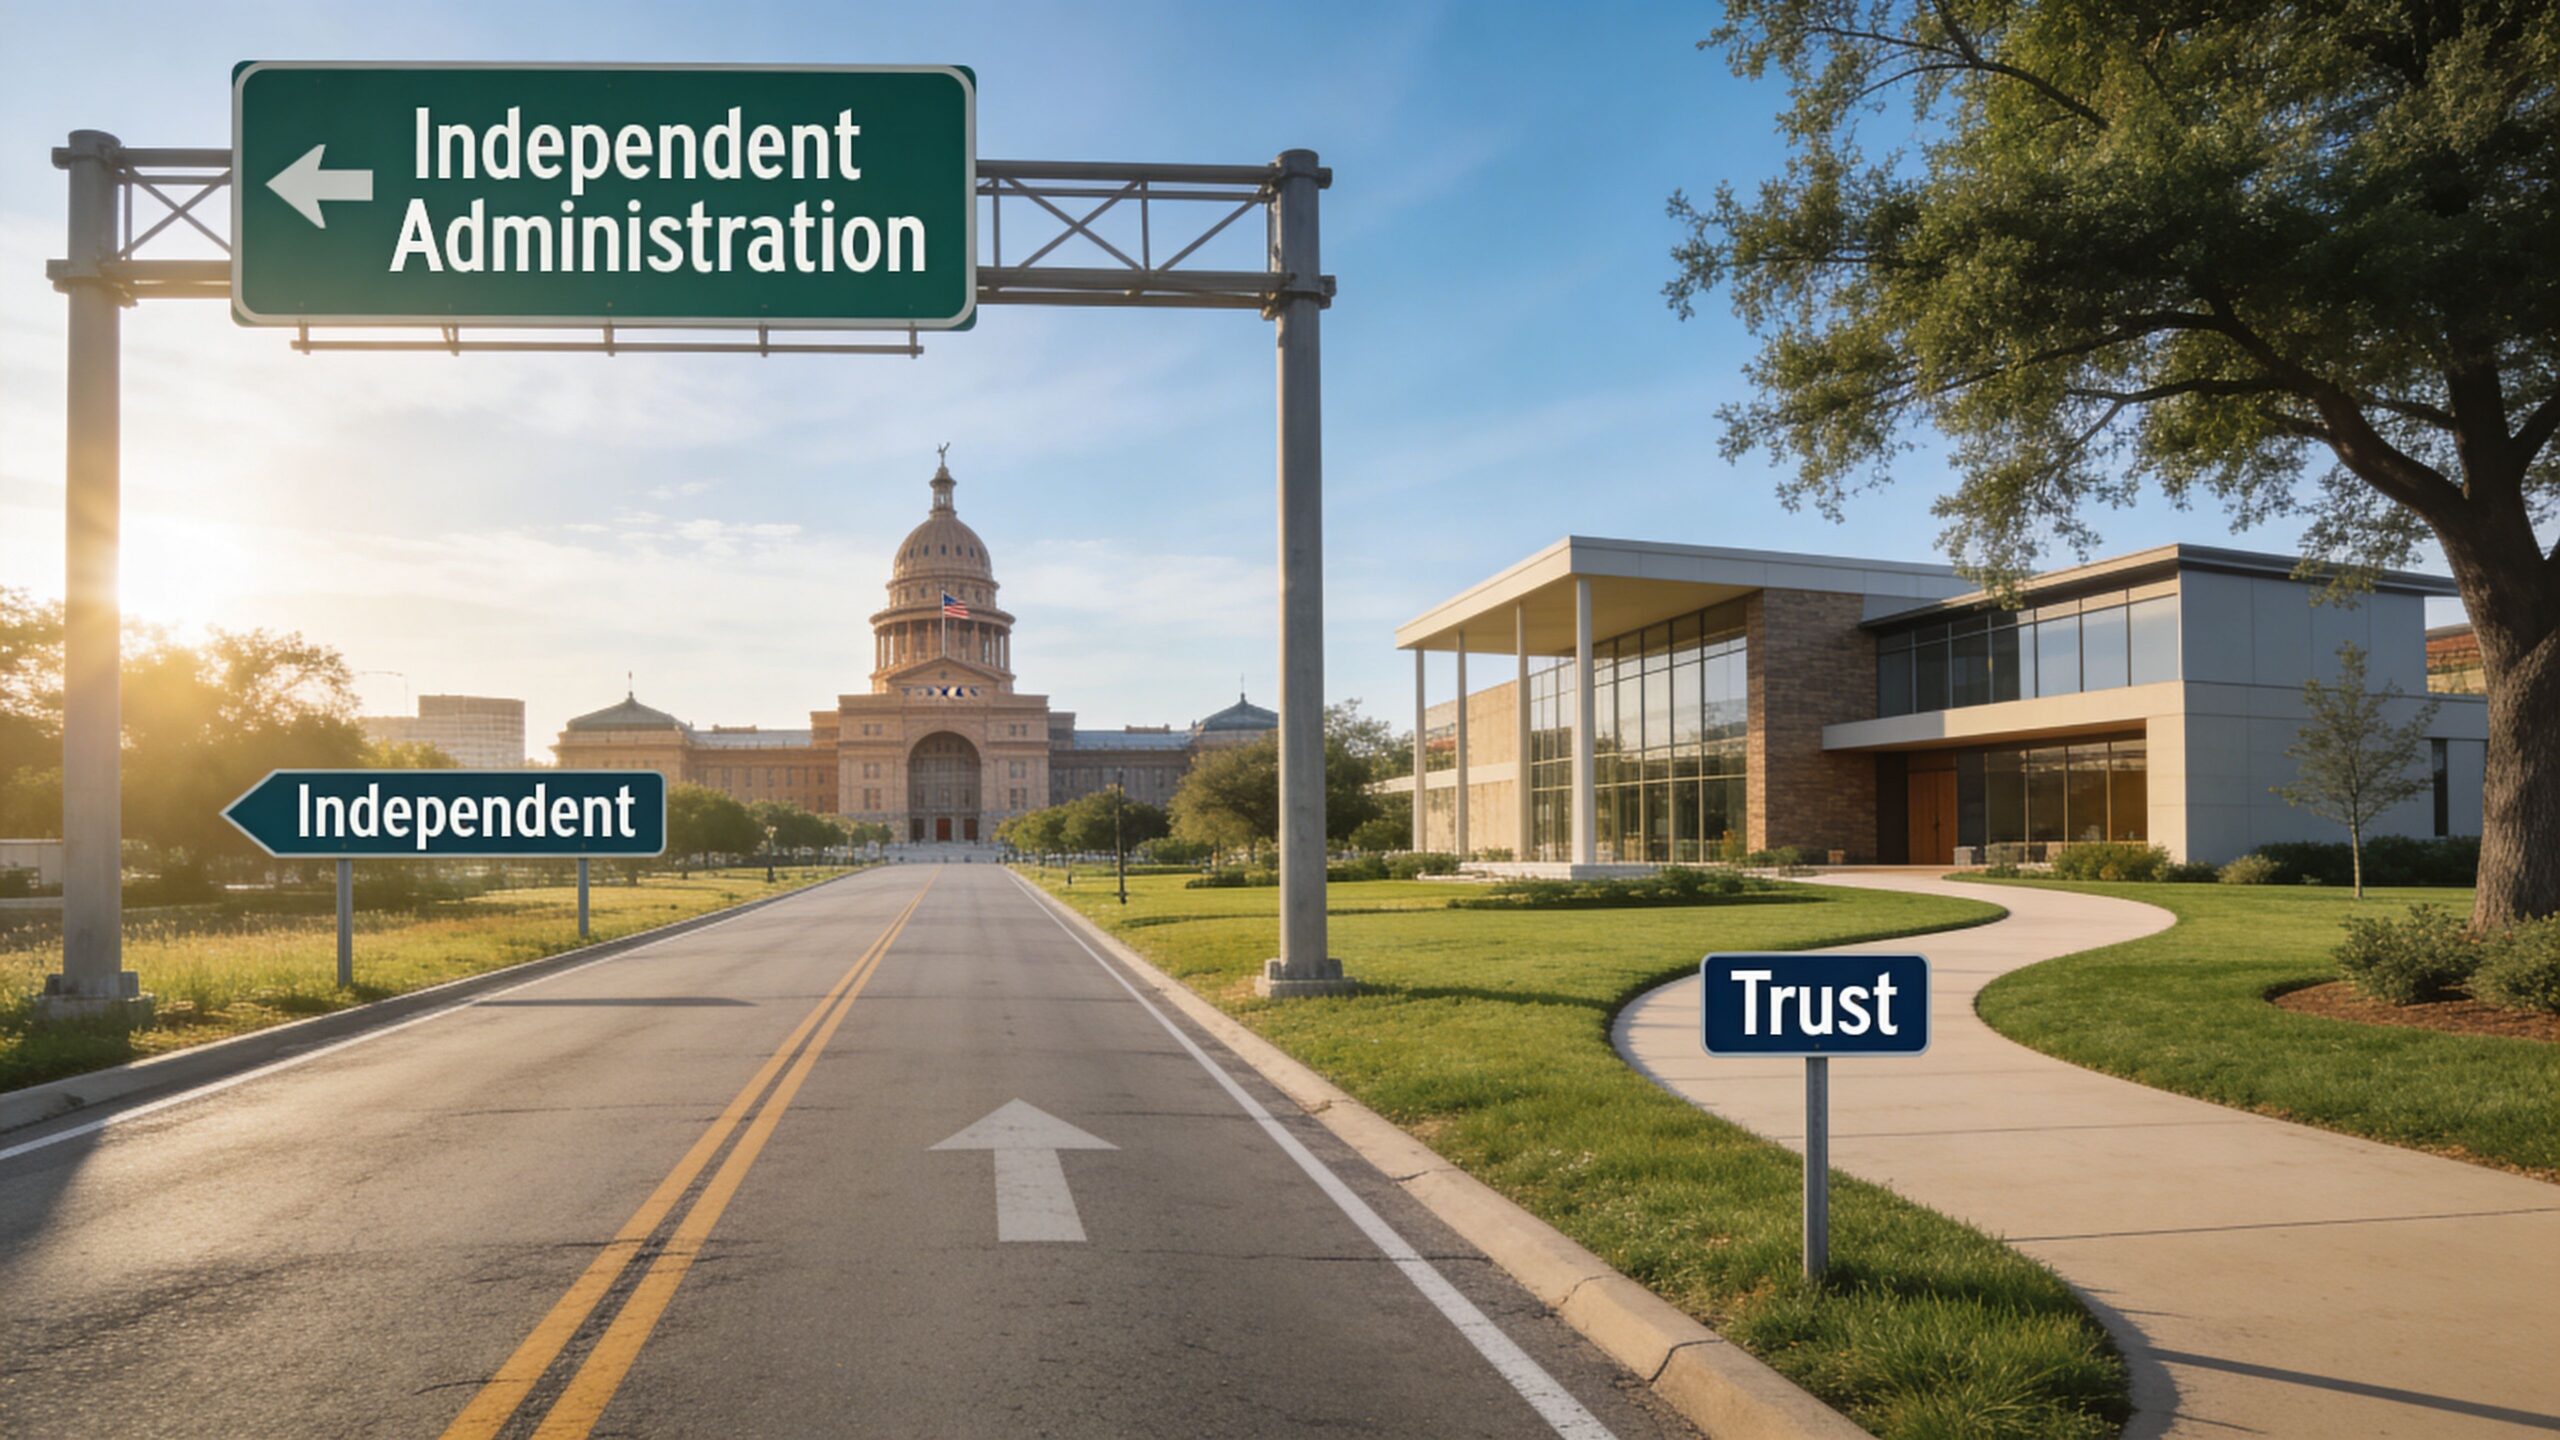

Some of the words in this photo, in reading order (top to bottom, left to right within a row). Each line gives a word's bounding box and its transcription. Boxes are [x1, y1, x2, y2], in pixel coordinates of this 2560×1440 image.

[415, 106, 861, 196] Independent
[389, 198, 926, 273] Administration
[298, 782, 637, 850] Independent
[1730, 970, 1898, 1036] Trust
